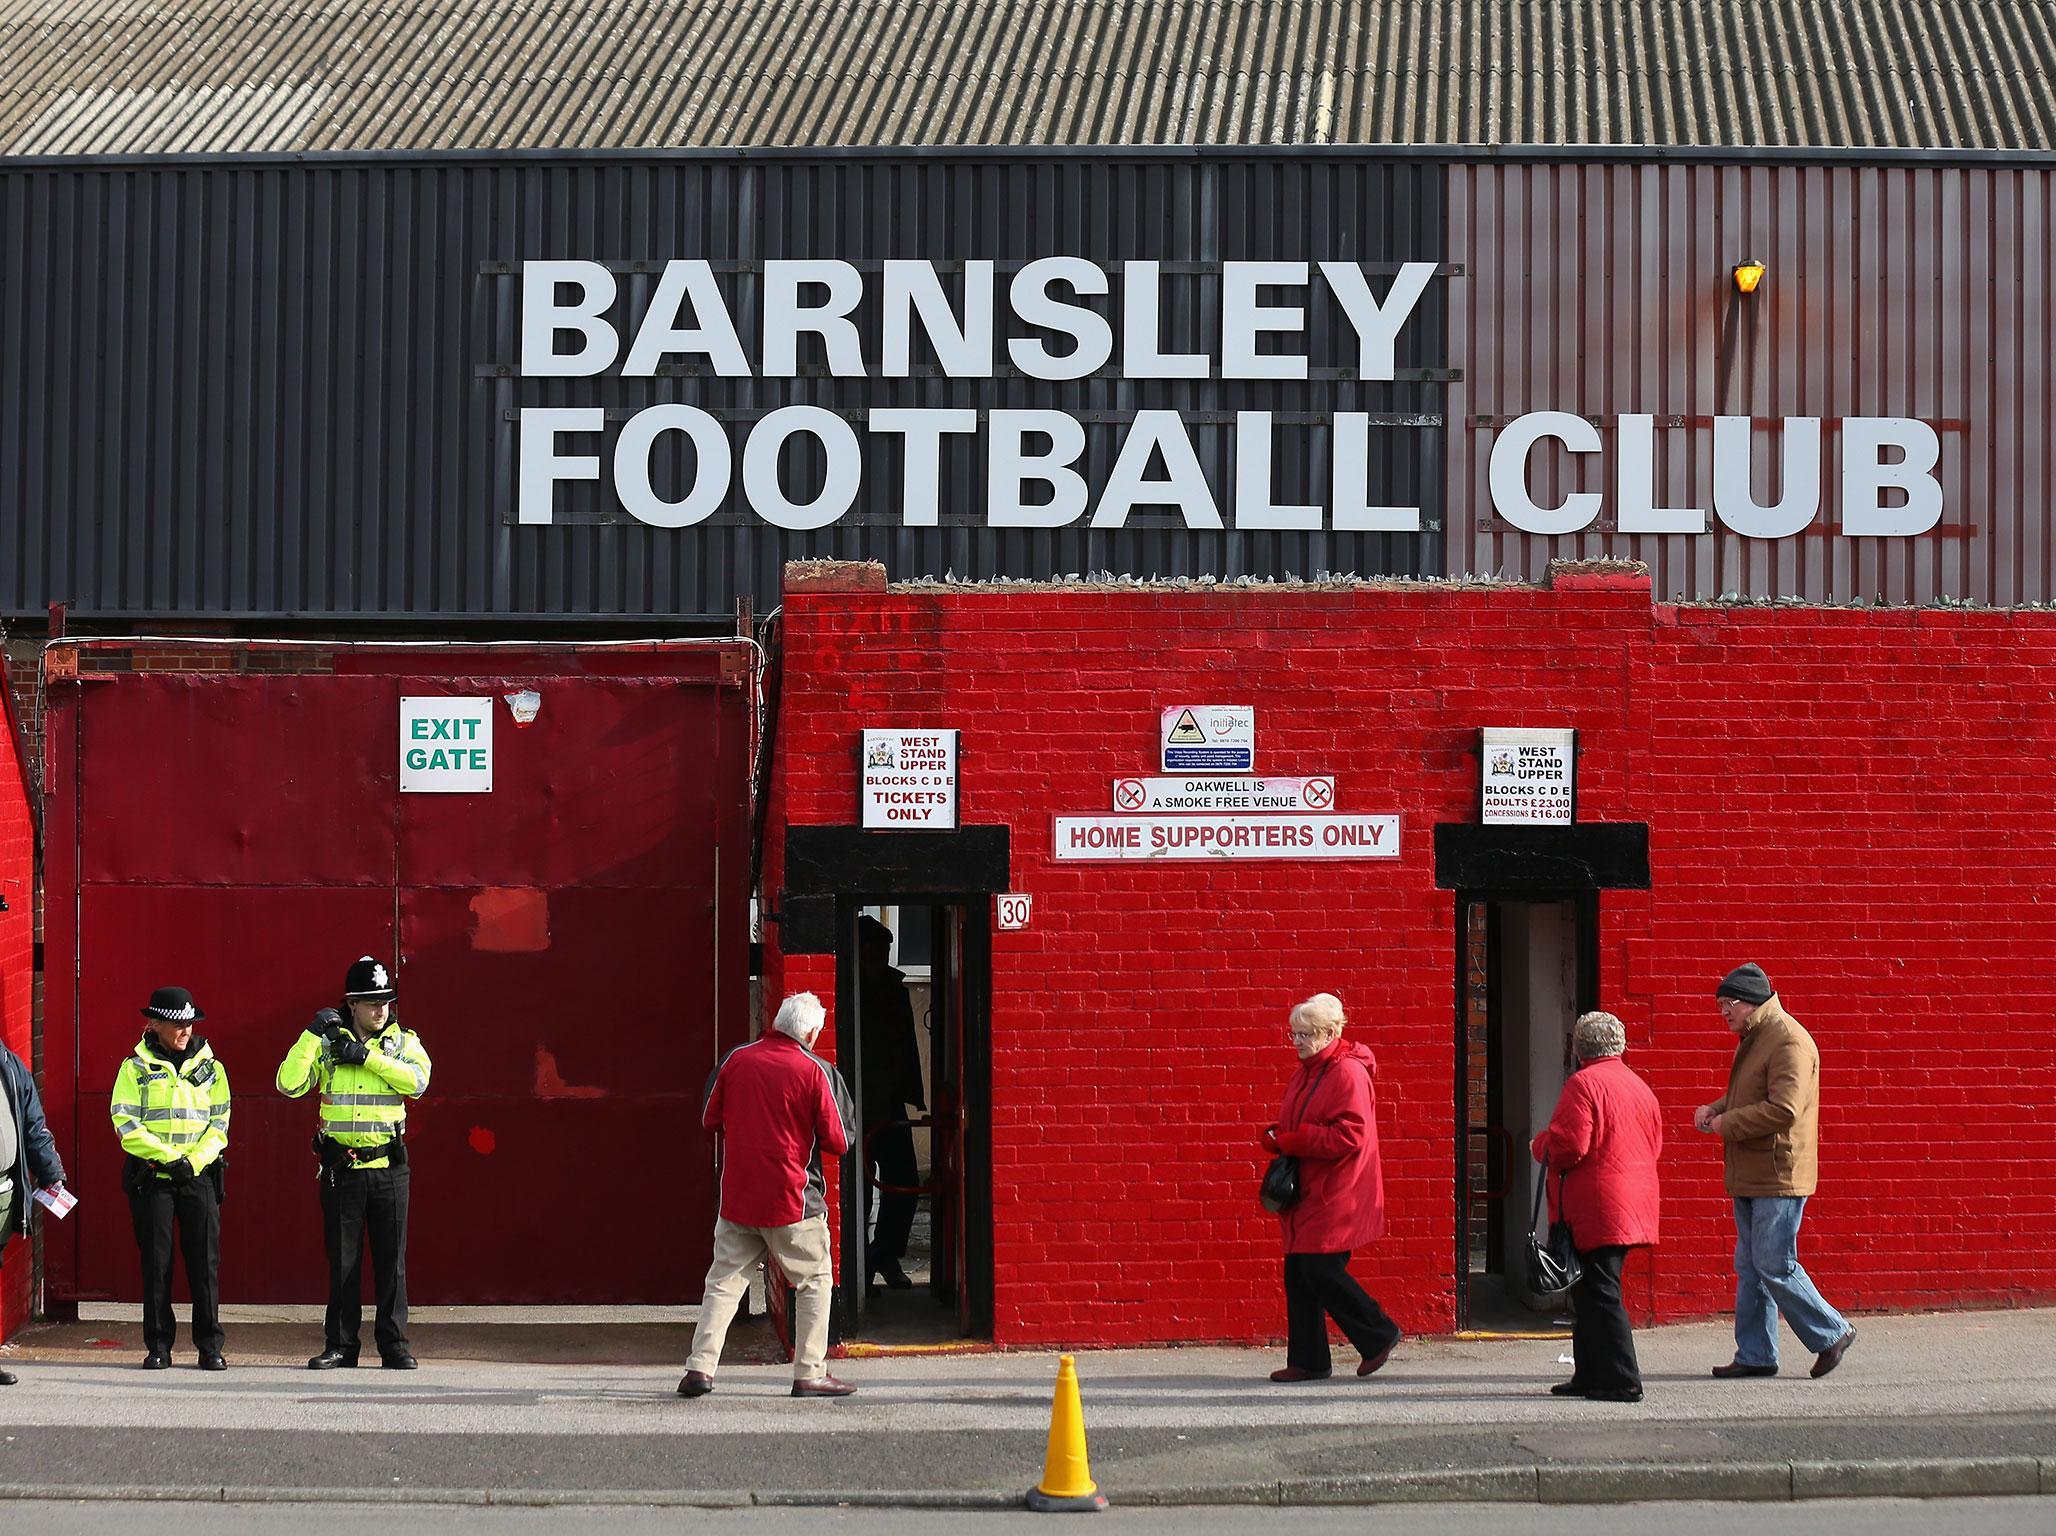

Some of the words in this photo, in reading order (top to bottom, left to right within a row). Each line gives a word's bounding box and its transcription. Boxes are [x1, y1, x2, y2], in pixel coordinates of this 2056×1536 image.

[520, 256, 1438, 381] BARNSLEY
[518, 404, 1420, 531] FOOTBALL
[1489, 411, 1943, 538] CLUB
[411, 719, 481, 740] EXIT
[900, 737, 939, 747] WEST
[900, 749, 946, 759] STAND
[1519, 747, 1556, 756] WEST
[406, 749, 486, 770] GATE
[1518, 758, 1563, 768] STAND
[900, 761, 947, 770] UPPER
[1518, 770, 1563, 779] UPPER
[866, 776, 917, 785] BLOCKS
[921, 777, 929, 785] C
[934, 777, 942, 785] D
[946, 777, 953, 785] E
[1185, 781, 1250, 792] OAKWELL
[1253, 781, 1265, 791] IS
[1485, 786, 1535, 795] BLOCKS
[1538, 787, 1546, 795] C
[1550, 787, 1558, 795] D
[1562, 787, 1570, 795] E
[873, 792, 947, 804] TICKETS
[1153, 797, 1162, 808] A
[1165, 797, 1212, 808] SMOKE
[1216, 797, 1250, 807] FREE
[1253, 796, 1297, 807] VENUE
[1485, 798, 1528, 806] ADULTS
[1530, 799, 1570, 808] £23.00
[887, 808, 932, 820] ONLY
[1485, 809, 1529, 818] CONCESSIONS
[1530, 810, 1570, 818] £16.00
[1070, 827, 1141, 848] HOME
[1151, 825, 1313, 848] SUPPORTERS
[1322, 825, 1384, 846] ONLY
[1003, 900, 1027, 924] 30
